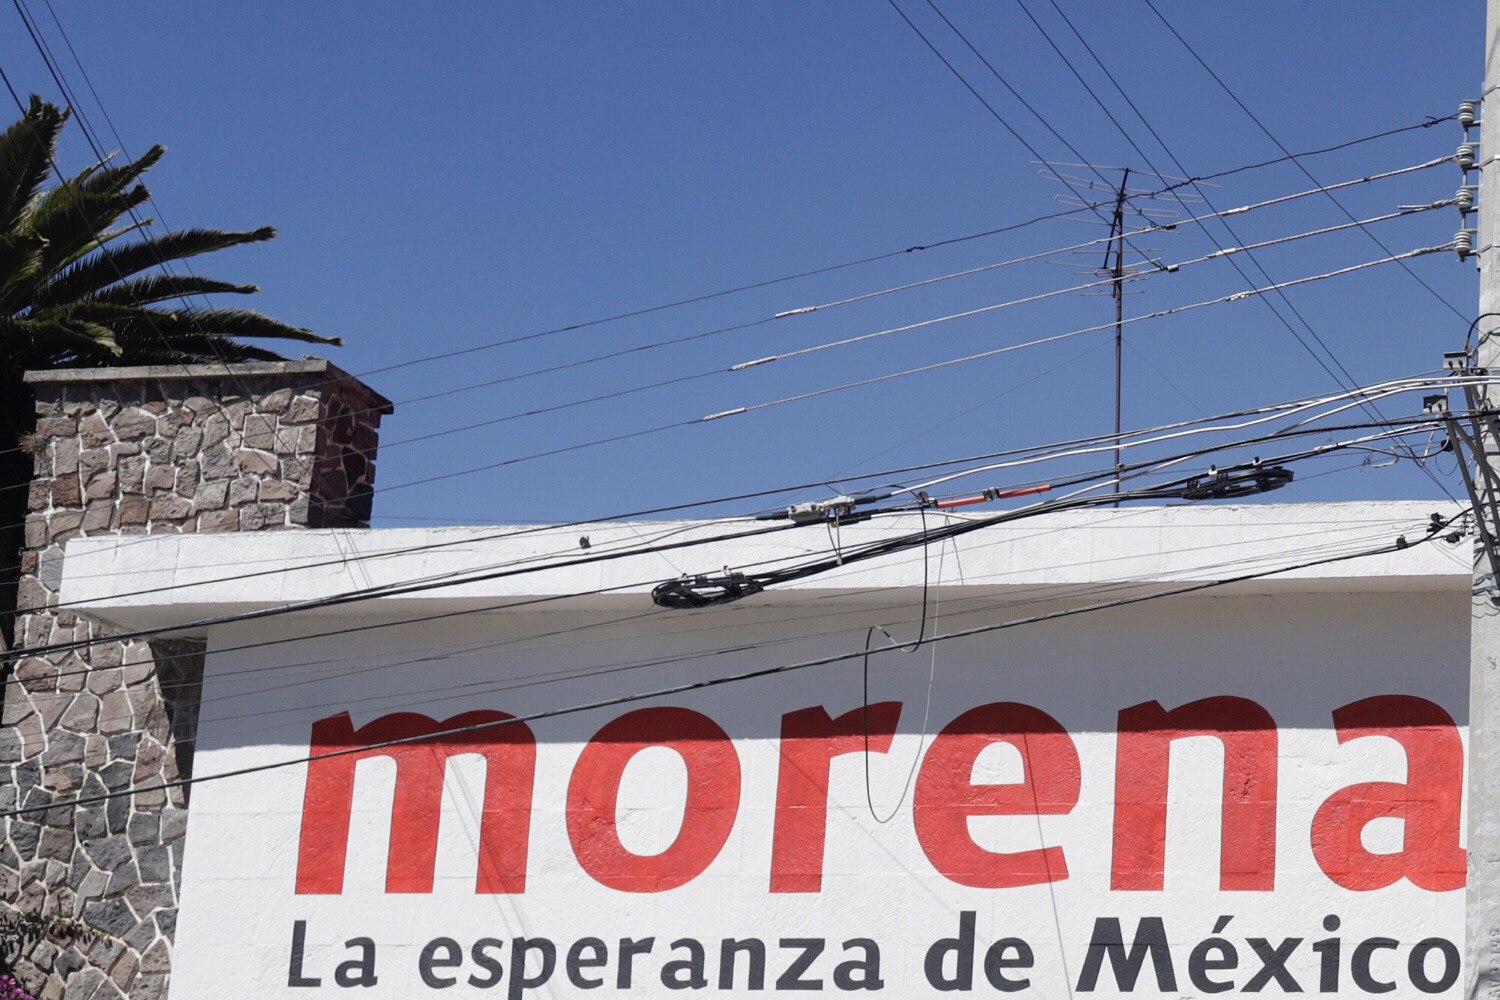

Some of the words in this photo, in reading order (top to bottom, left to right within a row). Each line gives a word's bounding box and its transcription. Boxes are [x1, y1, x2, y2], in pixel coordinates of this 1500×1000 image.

[295, 695, 1468, 895] morena
[287, 920, 378, 988] La
[923, 911, 1035, 992] de
[1075, 914, 1461, 994] México
